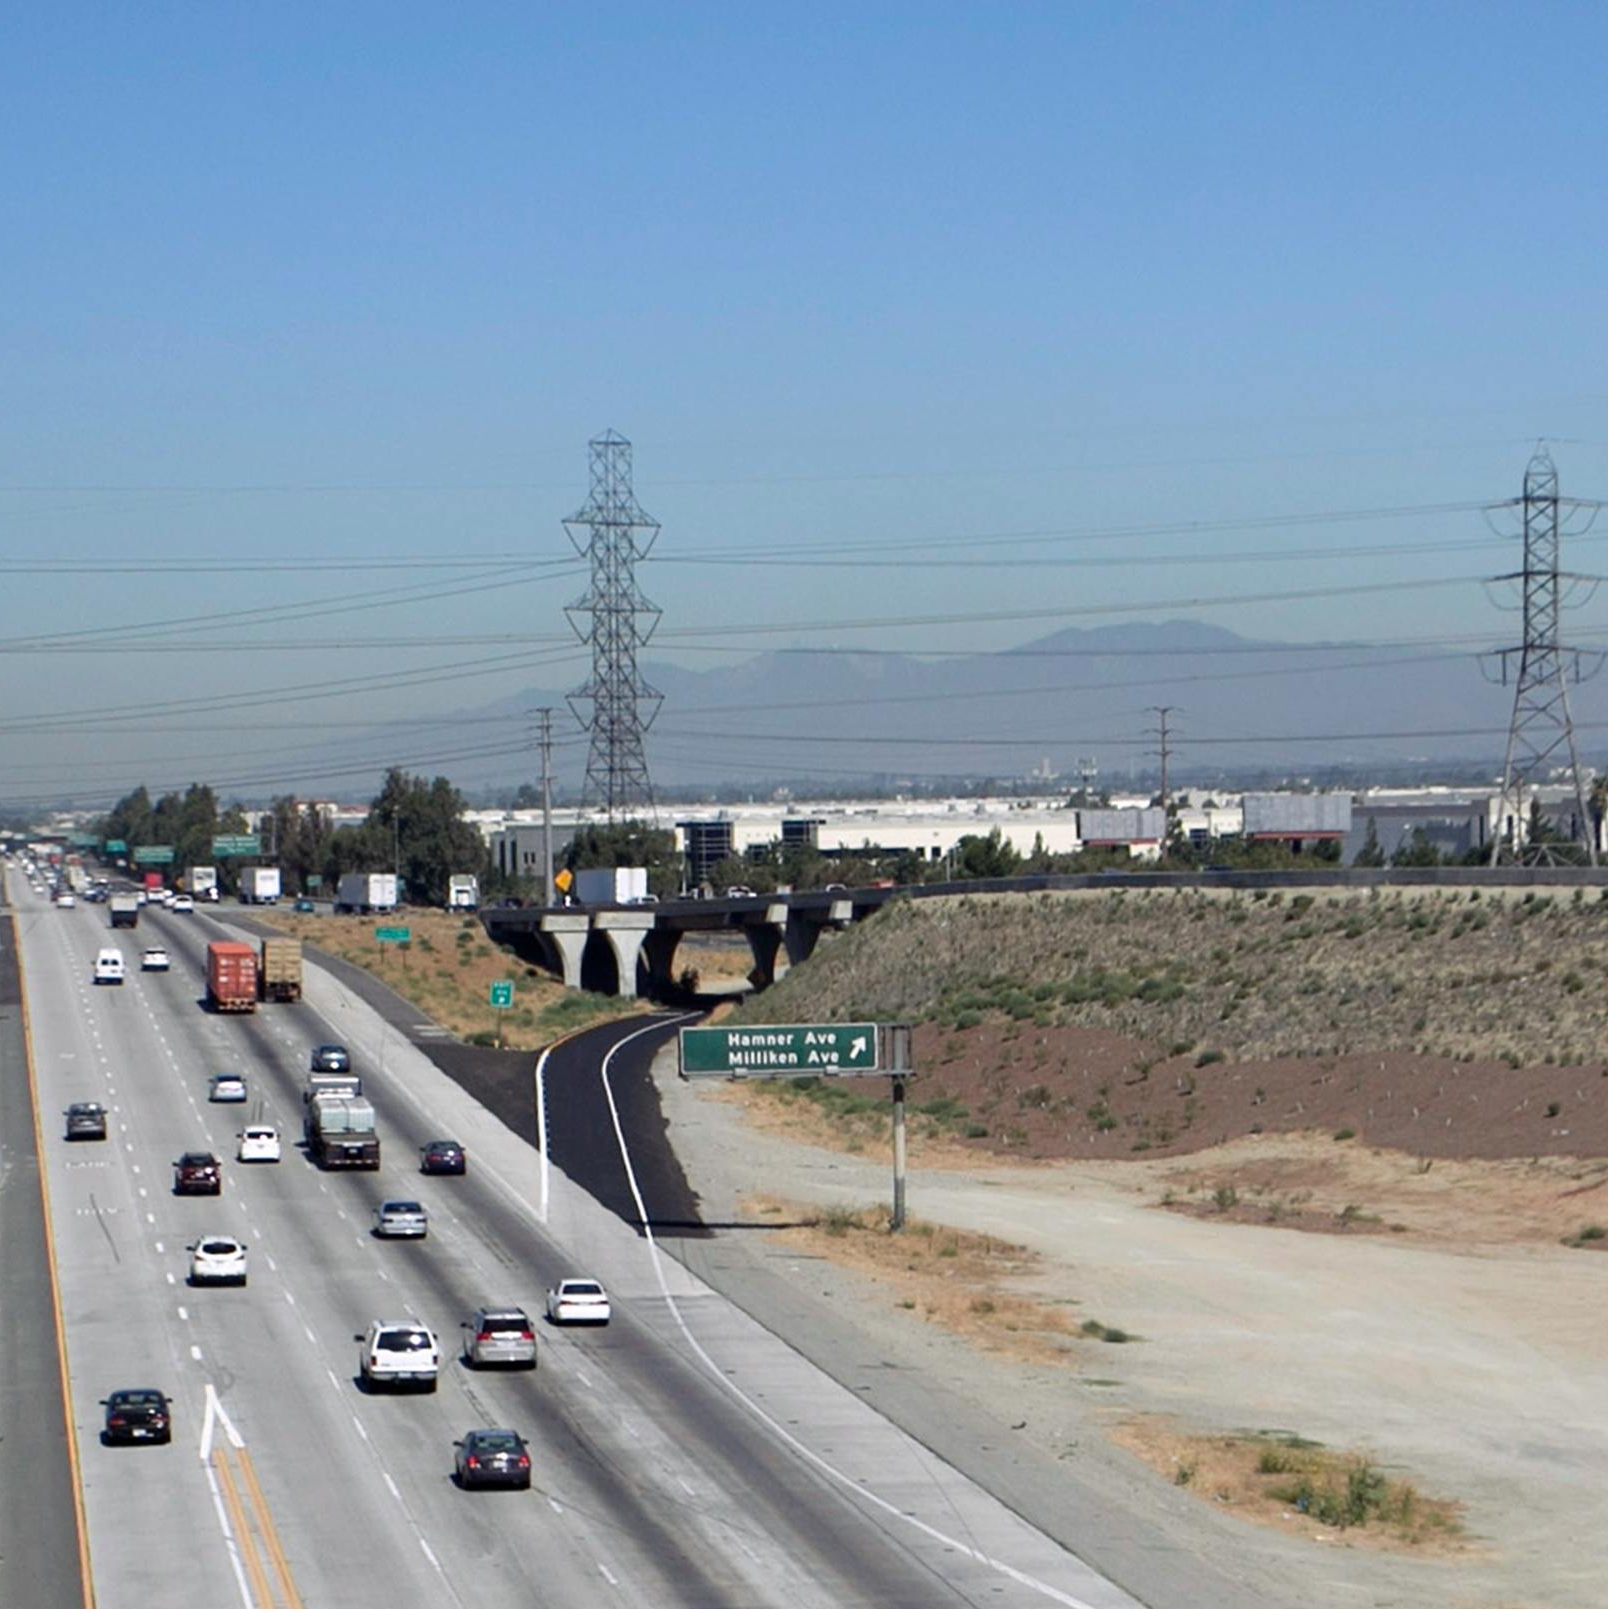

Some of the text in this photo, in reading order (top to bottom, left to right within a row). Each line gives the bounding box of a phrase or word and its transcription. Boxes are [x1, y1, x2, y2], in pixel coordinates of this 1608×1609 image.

[728, 1031, 837, 1047] Hamner Ave
[728, 1050, 840, 1065] Milliken Ave
